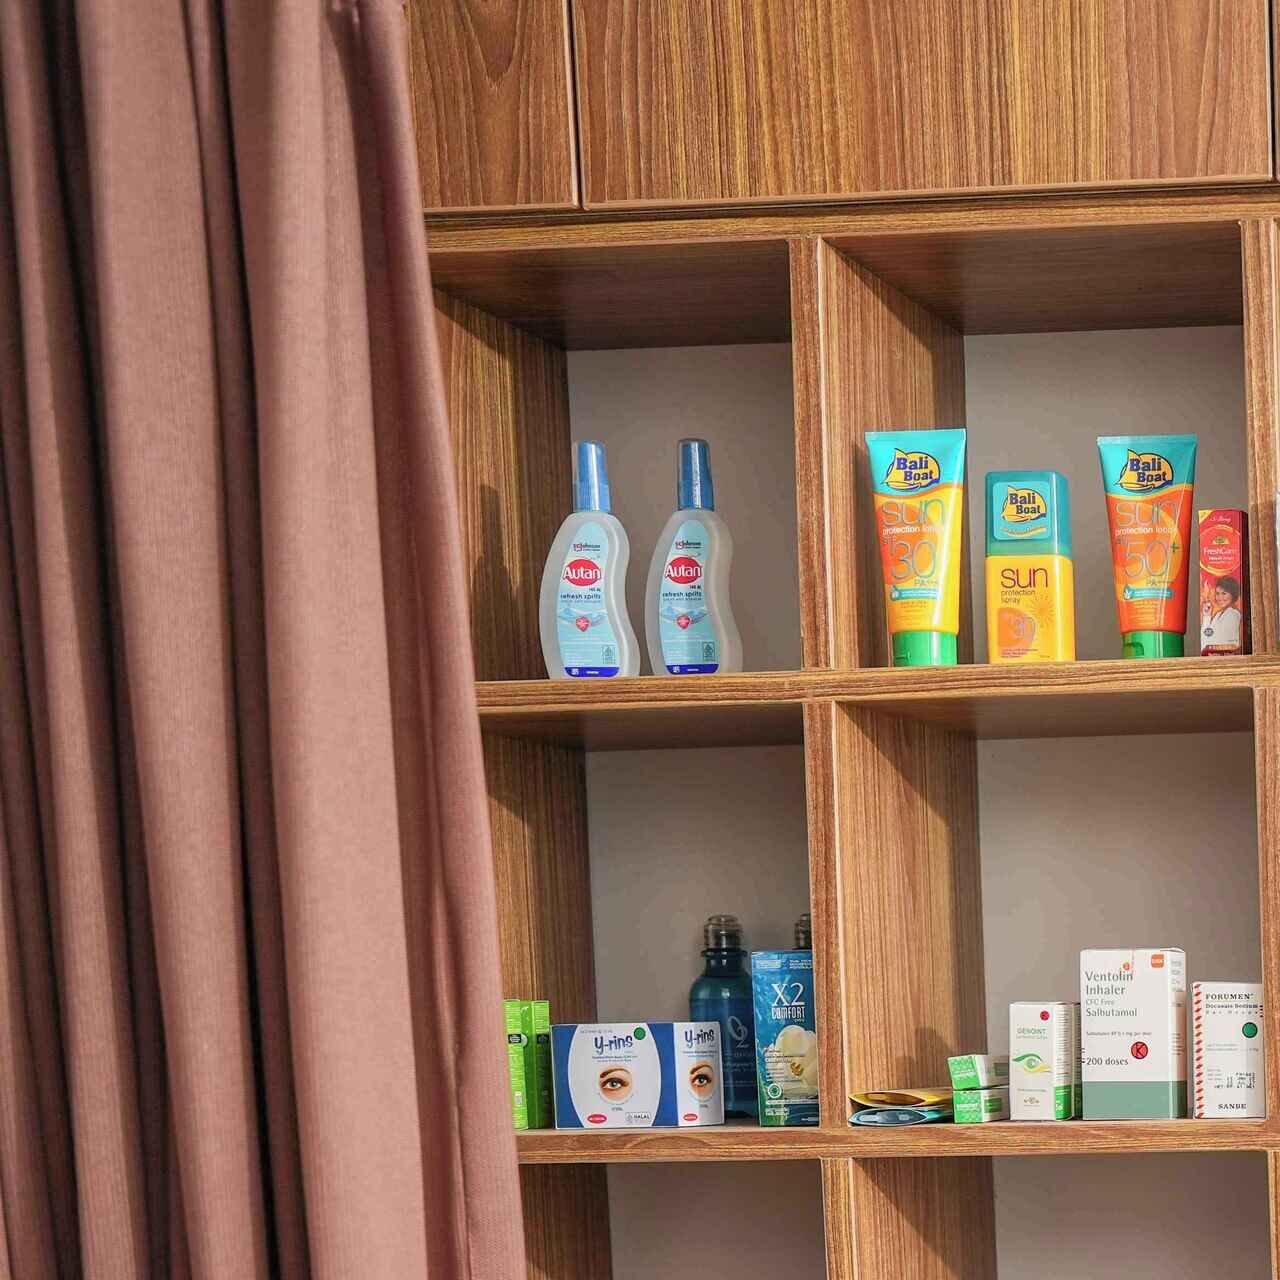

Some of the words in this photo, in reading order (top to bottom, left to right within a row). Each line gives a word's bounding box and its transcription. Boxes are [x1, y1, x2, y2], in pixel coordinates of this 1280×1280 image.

[896, 456, 929, 471] Bali
[1129, 457, 1162, 472] Bali
[904, 470, 933, 482] Boat
[1137, 471, 1167, 483] Boat
[1009, 493, 1036, 506] Bali
[881, 499, 946, 526] sun
[1016, 504, 1041, 515] Boat
[1115, 501, 1179, 528] sun
[890, 540, 936, 580] 30
[562, 566, 602, 580] Autan
[664, 565, 703, 578] Autan
[1001, 567, 1048, 589] sun
[1085, 971, 1133, 982] Ventolin
[772, 982, 805, 1006] X2
[1085, 984, 1126, 995] Inhaler
[771, 1007, 805, 1019] COMFORT
[1086, 1007, 1138, 1017] Salbutamol
[1105, 1057, 1129, 1065] doses
